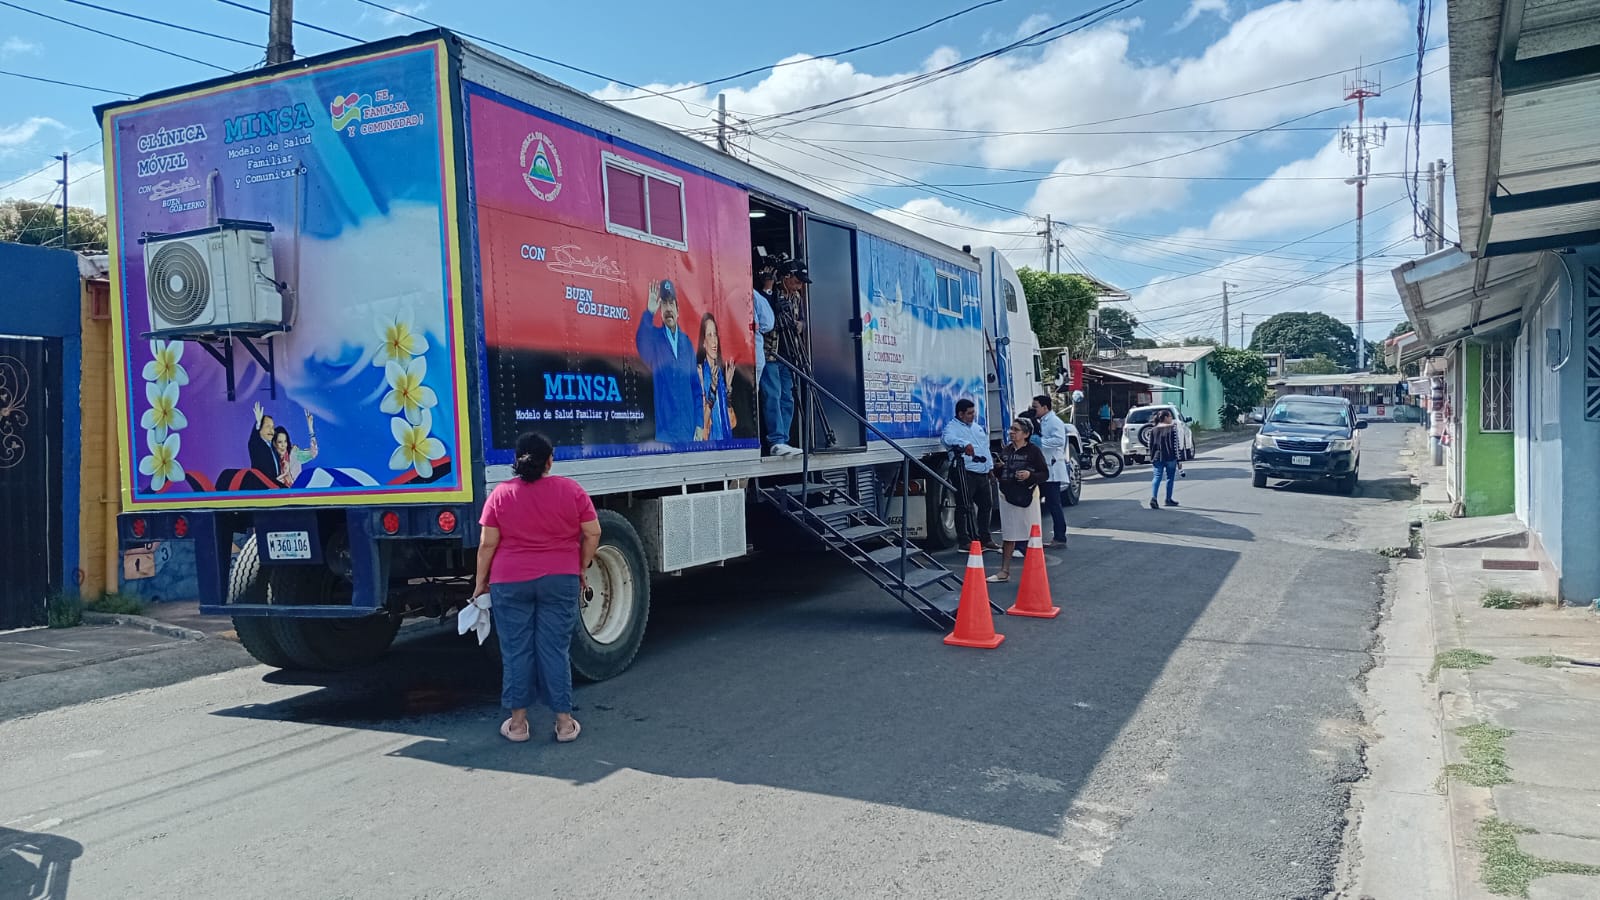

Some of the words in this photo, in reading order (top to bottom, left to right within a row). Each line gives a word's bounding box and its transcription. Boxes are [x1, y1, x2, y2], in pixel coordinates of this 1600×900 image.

[363, 101, 409, 119] FAMILIA
[224, 102, 315, 144] MINSA
[138, 124, 207, 152] CLÍNICA
[347, 126, 356, 137] Y
[228, 144, 261, 159] Modelo
[266, 142, 279, 151] de
[283, 133, 312, 148] Salud
[138, 152, 188, 177] MÓVIL
[247, 154, 293, 169] Familiar
[138, 184, 152, 194] CON
[235, 178, 241, 188] y
[162, 198, 180, 207] BUEN
[520, 244, 547, 262] CON
[565, 286, 593, 302] BUEN
[543, 373, 623, 402] MINSA
[515, 410, 541, 420] Modelo
[543, 409, 552, 419] de
[554, 409, 574, 419] Salud
[575, 409, 602, 419] Familiar
[603, 411, 609, 421] y
[277, 539, 292, 552] 360
[294, 539, 308, 552] 106
